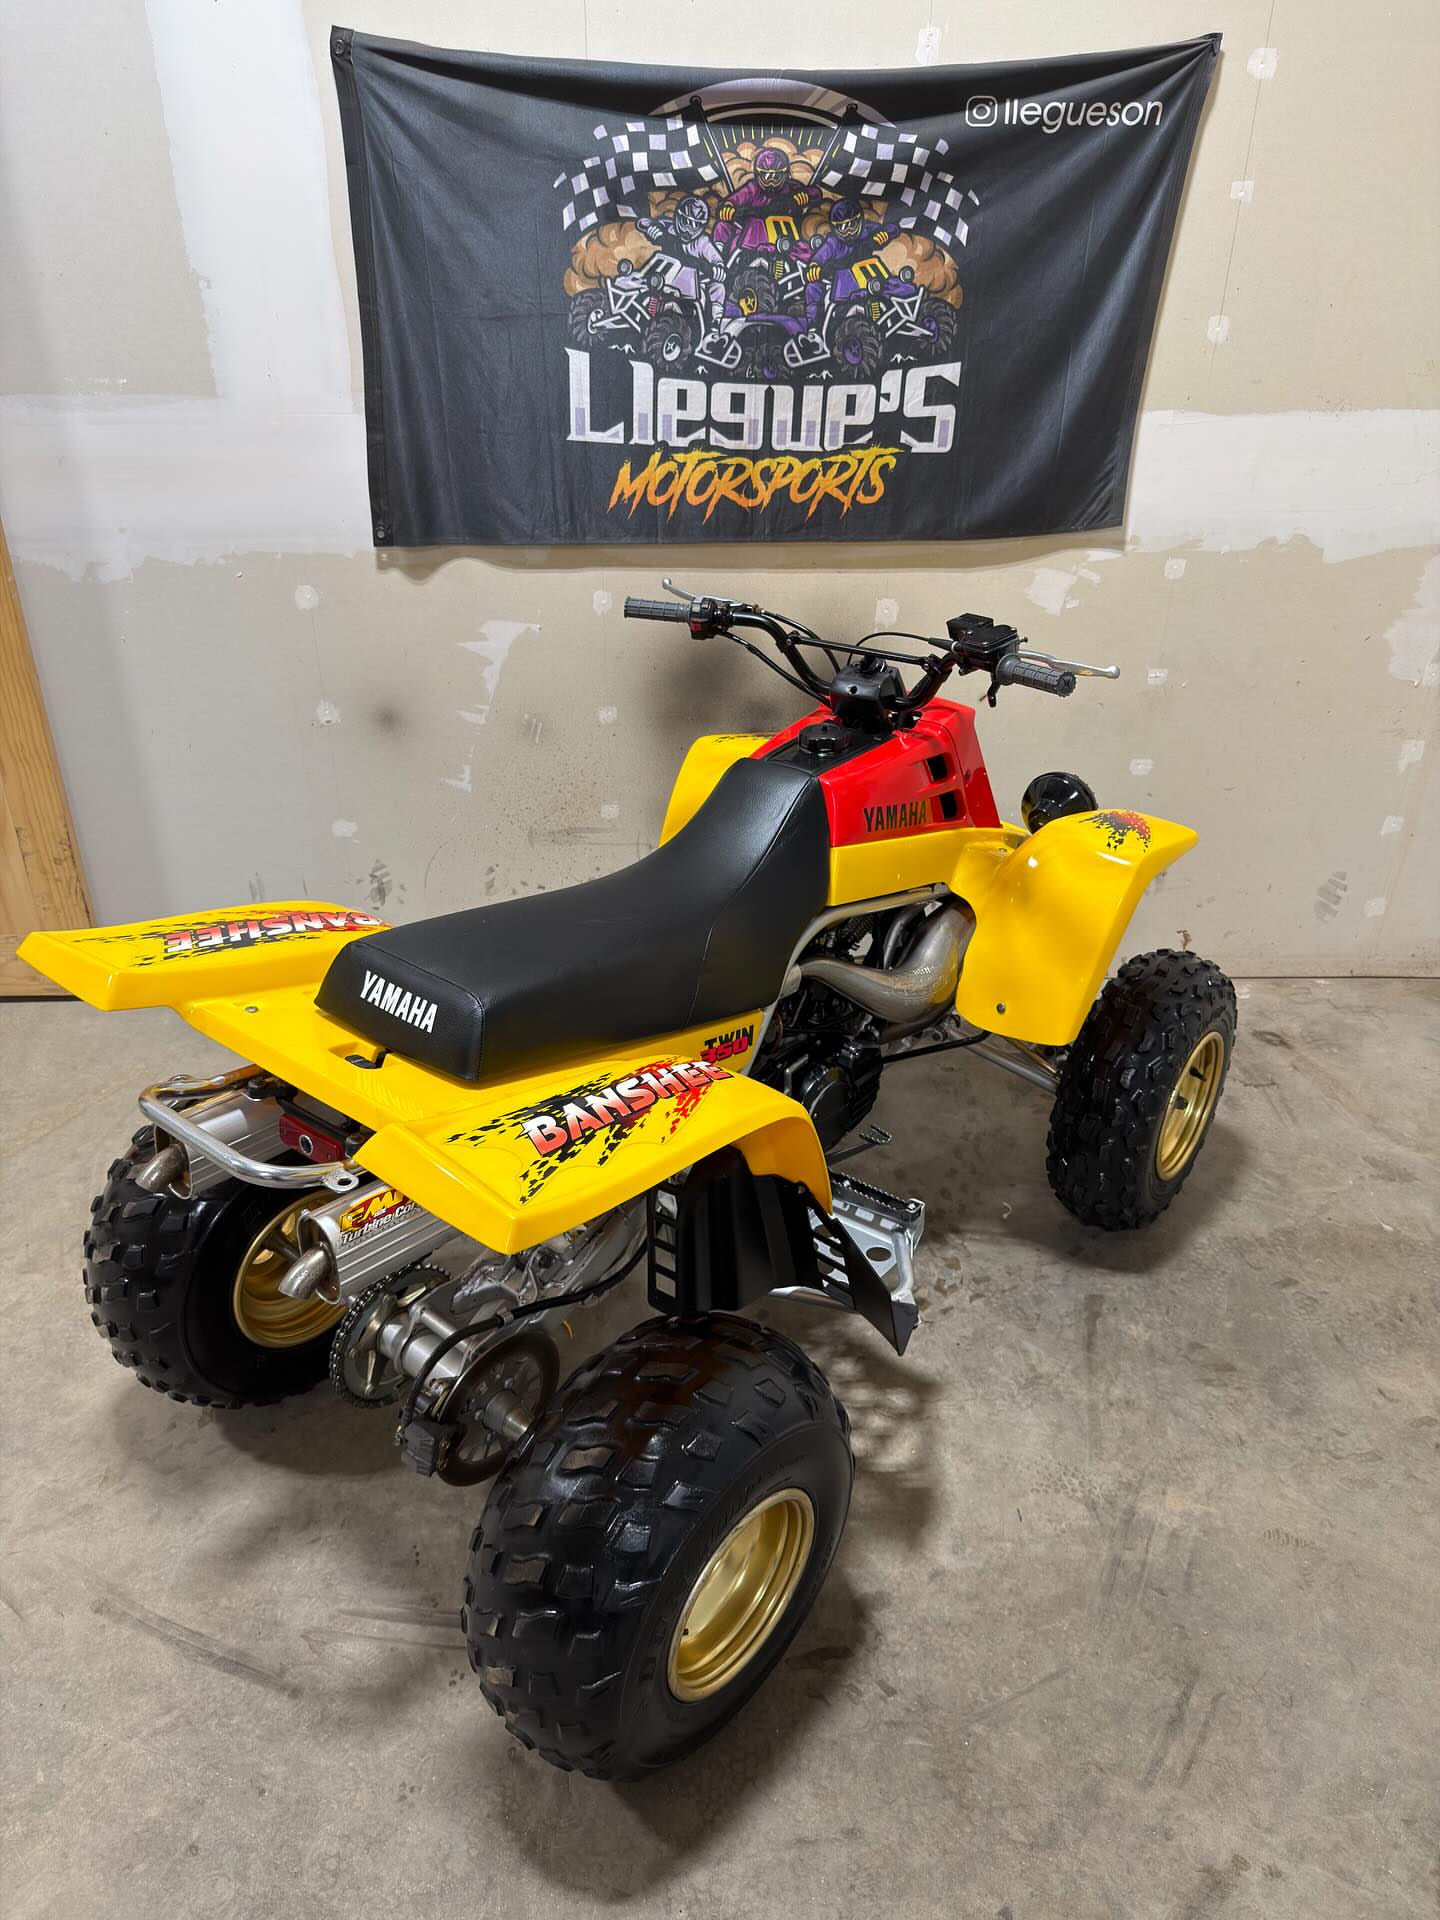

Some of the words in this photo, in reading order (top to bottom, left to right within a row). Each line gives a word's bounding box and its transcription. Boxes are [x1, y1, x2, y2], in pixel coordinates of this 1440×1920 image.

[1004, 98, 1163, 134] llegueson
[606, 446, 906, 525] MOTORSPORTS
[863, 800, 927, 833] YAMAHA
[164, 911, 382, 954] BANSHEE
[360, 969, 438, 1034] YAMAHA
[700, 1035, 750, 1063] 350
[704, 1024, 754, 1049] TWIN
[521, 1060, 734, 1157] BANSHEE
